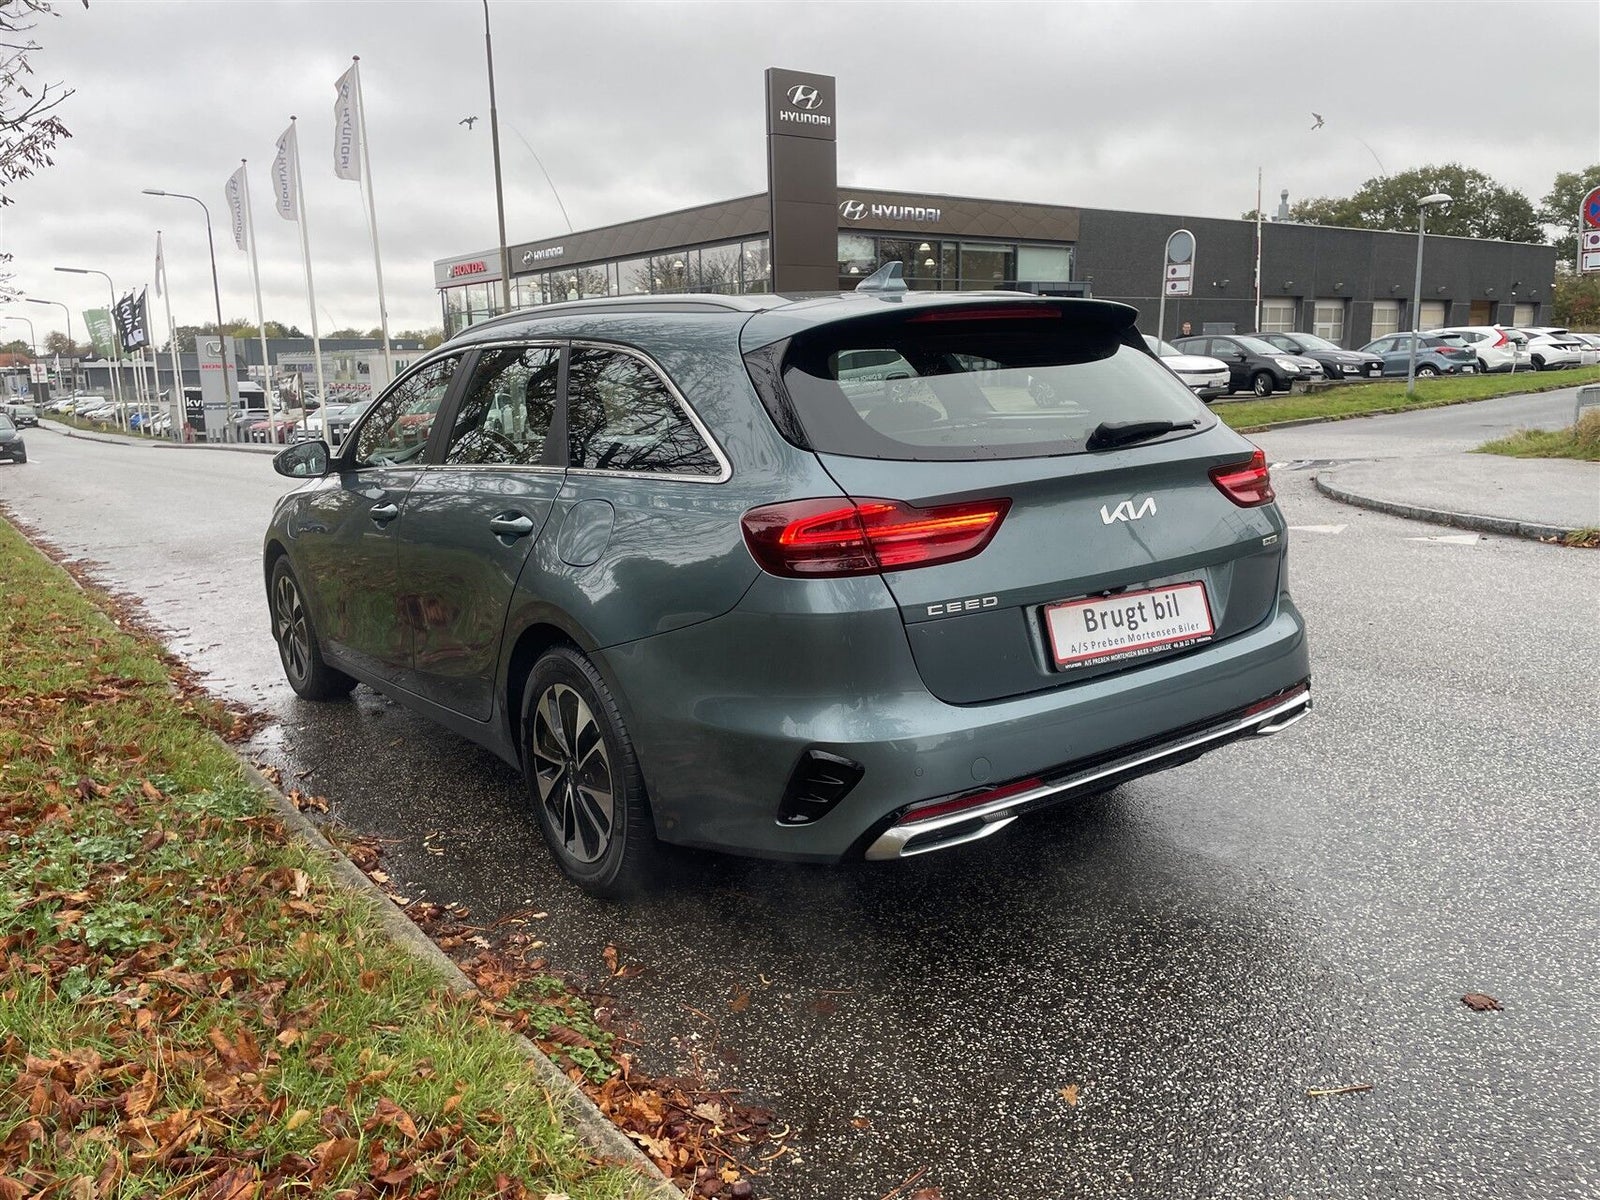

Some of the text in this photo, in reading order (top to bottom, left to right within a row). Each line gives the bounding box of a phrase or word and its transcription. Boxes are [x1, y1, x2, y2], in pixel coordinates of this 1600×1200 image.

[780, 110, 832, 126] HYUNDAI
[341, 107, 352, 169] HYUNDAI
[278, 153, 291, 212] HYUNDAI
[871, 204, 941, 222] HYUNDAI
[533, 246, 564, 261] HYUNDAI
[453, 261, 486, 277] HONDA
[186, 396, 204, 407] kvi
[1100, 497, 1157, 525] KIA
[927, 596, 998, 616] CEED
[1083, 592, 1180, 632] Brugt bil
[1071, 622, 1200, 653] A/S Preben Mortensen Biler
[1092, 656, 1111, 665] PREBEN
[1111, 651, 1137, 661] MORTENSEN
[1137, 648, 1149, 657] BILER
[1153, 644, 1172, 653] ROSKILDE
